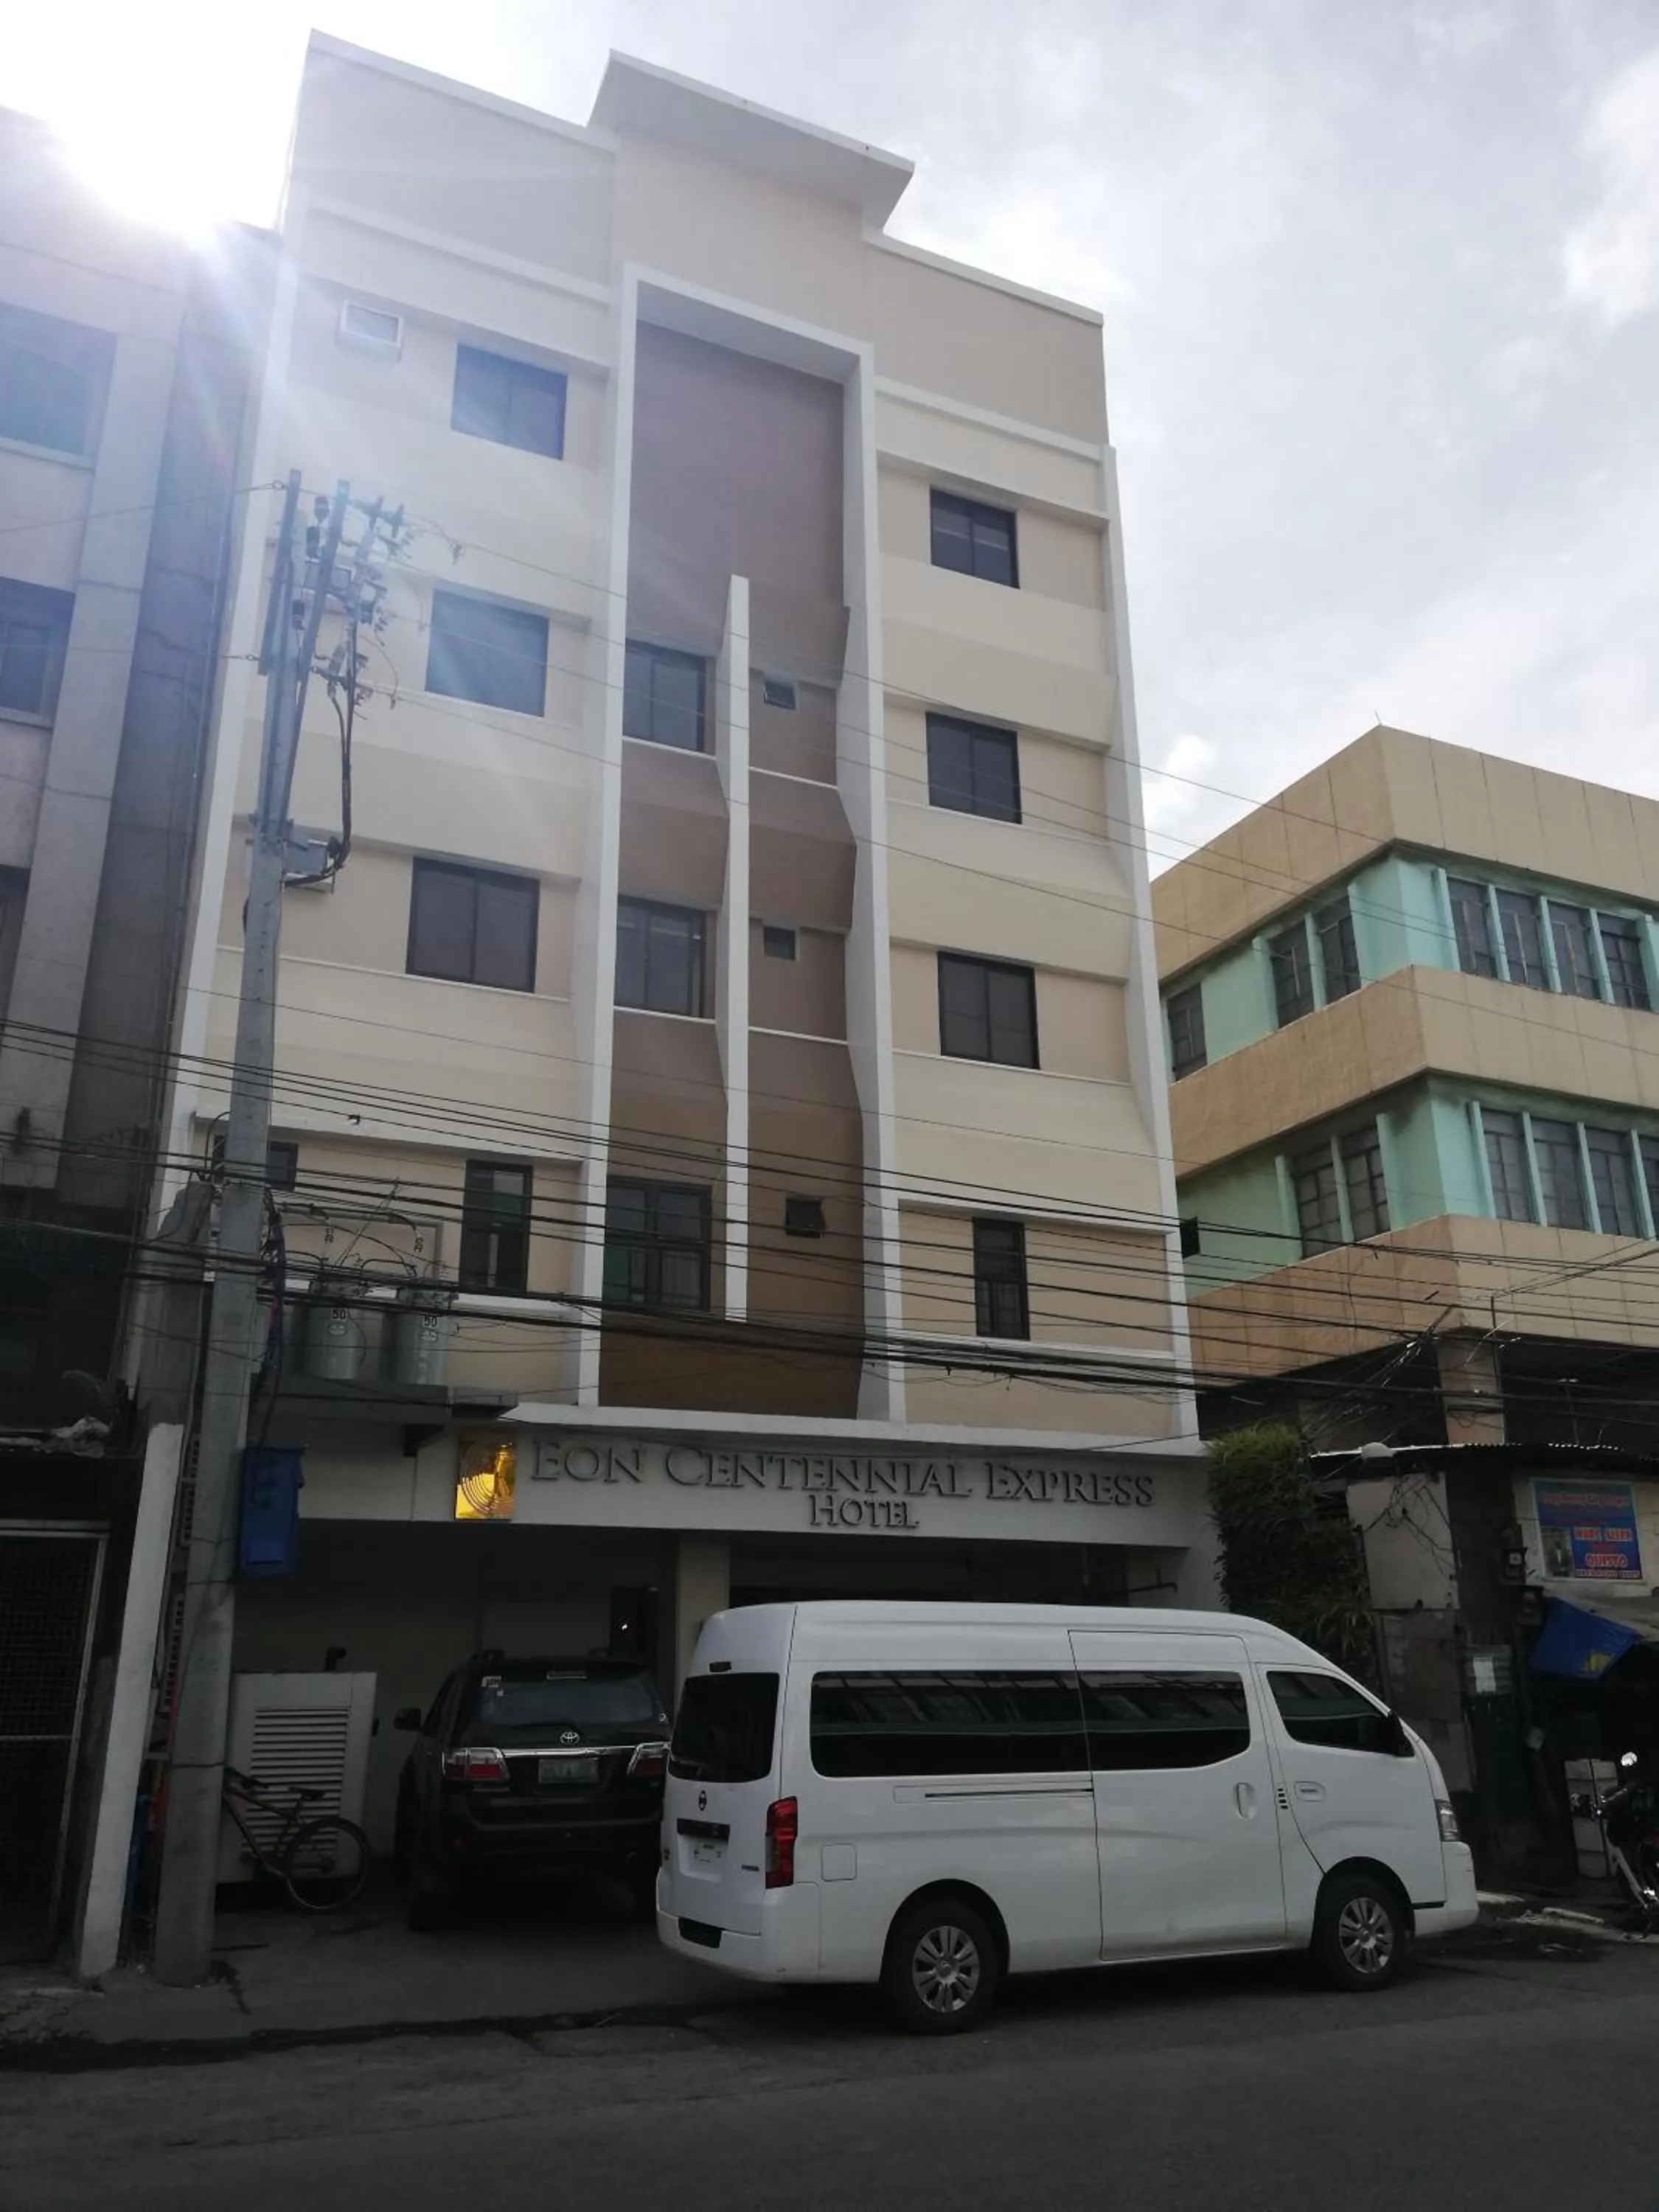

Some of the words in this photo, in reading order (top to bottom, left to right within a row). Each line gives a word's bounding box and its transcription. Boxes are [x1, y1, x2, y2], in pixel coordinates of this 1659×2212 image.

[531, 1439, 643, 1484] EON
[666, 1447, 973, 1498] CENTENNIAL
[985, 1461, 1156, 1507] EXPRESS
[810, 1493, 920, 1529] HOTEL
